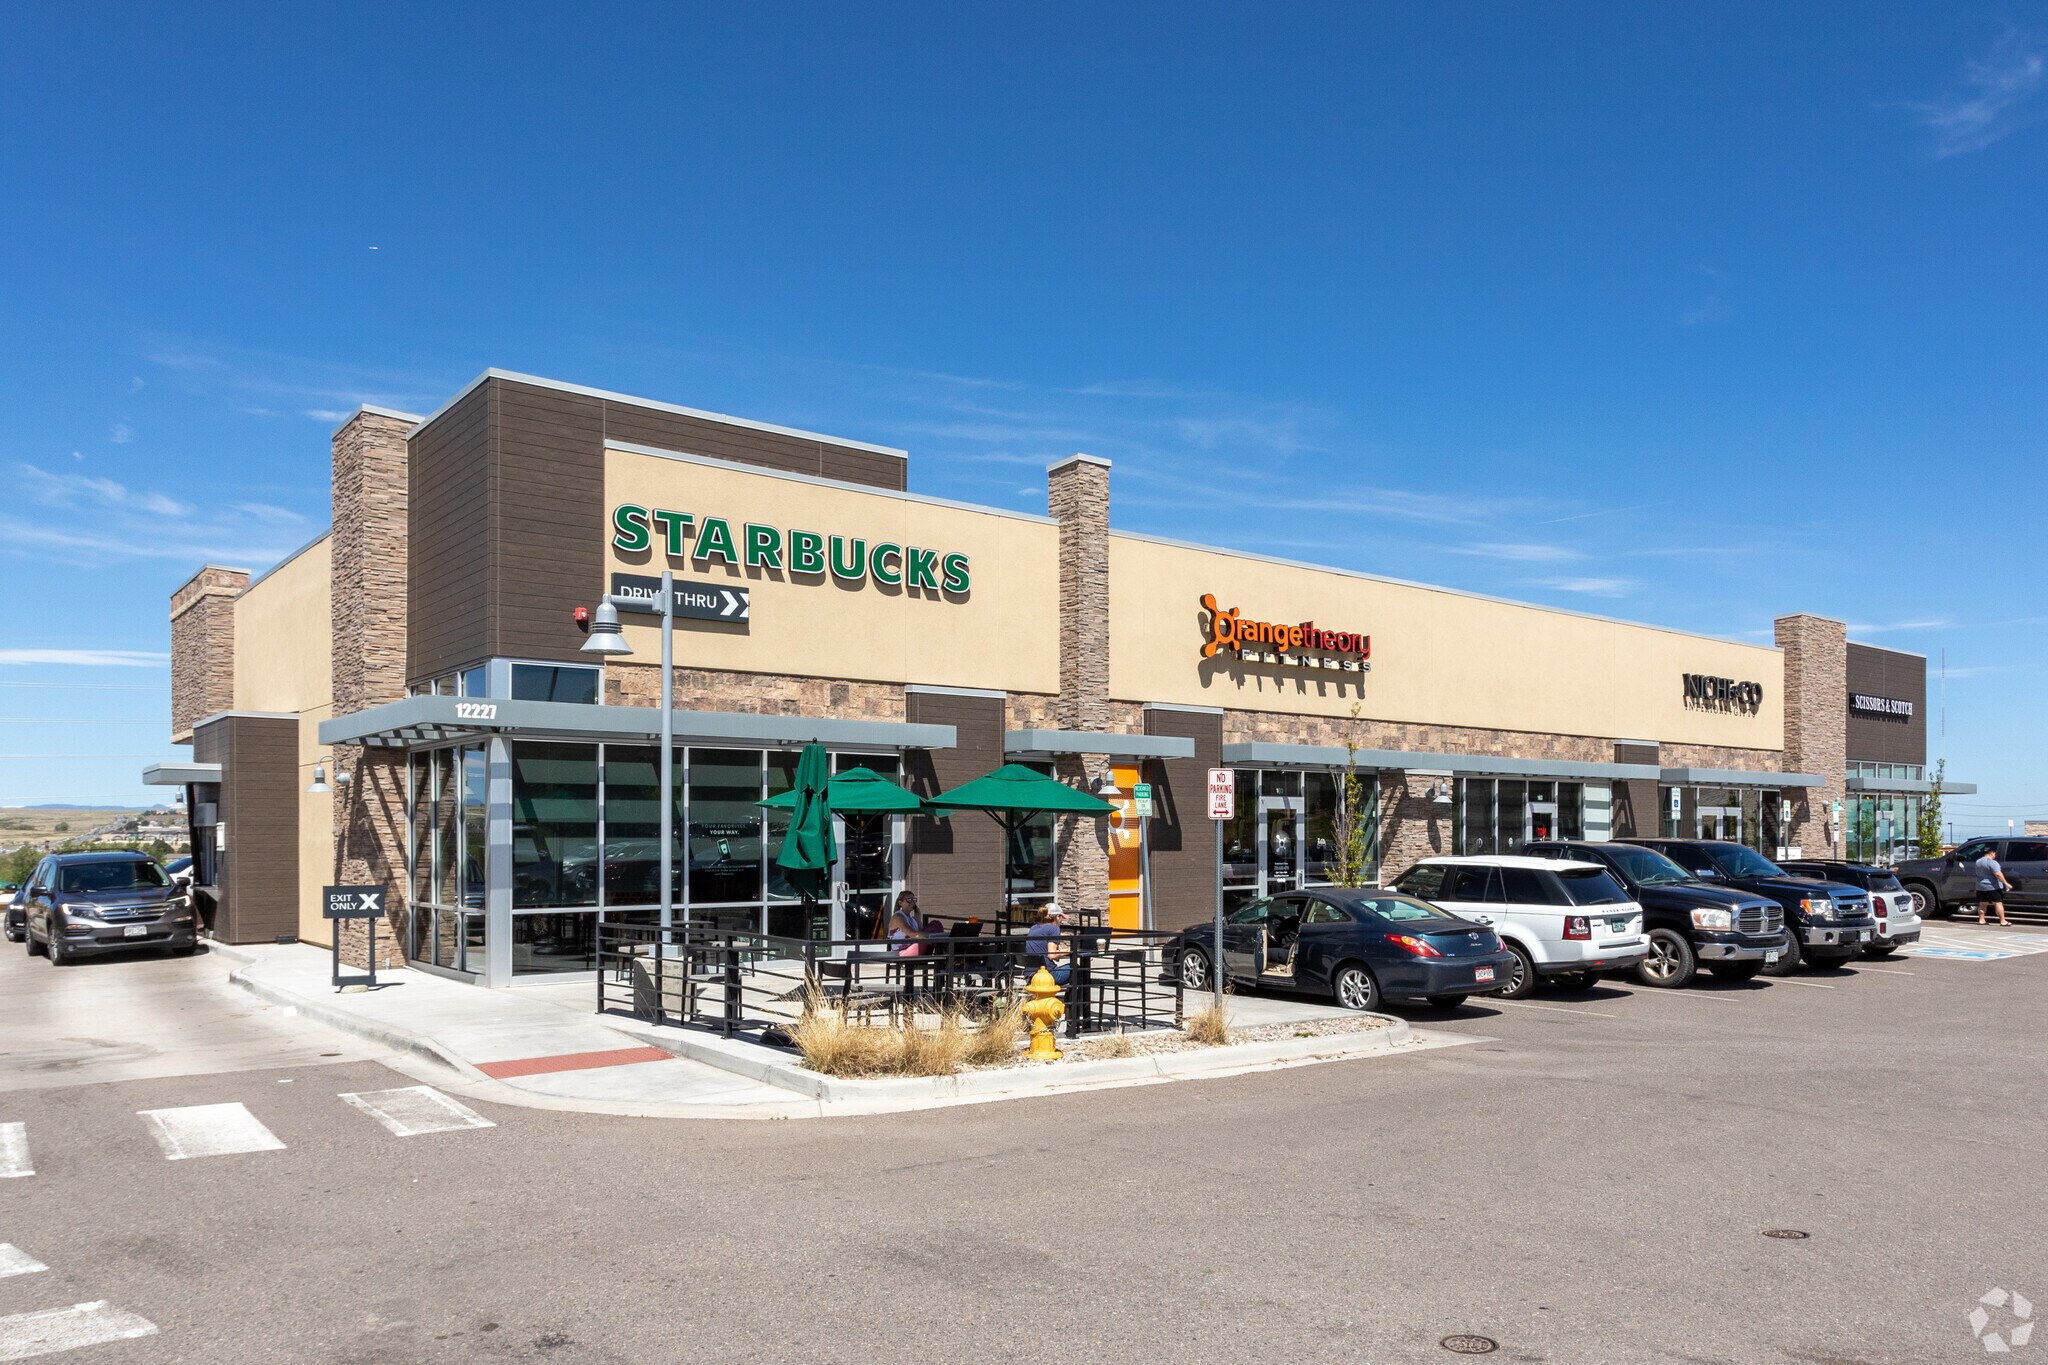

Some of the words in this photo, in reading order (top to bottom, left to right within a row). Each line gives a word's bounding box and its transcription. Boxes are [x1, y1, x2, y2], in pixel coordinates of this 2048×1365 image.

[613, 504, 972, 594] STARBUCKS
[620, 585, 664, 600] DRIV
[674, 591, 717, 609] THRU
[1240, 649, 1371, 673] FITNESS
[1855, 695, 1885, 712] SCISSORS
[1885, 698, 1890, 713] &
[1891, 700, 1913, 716] SCOTCH
[455, 702, 497, 720] 12227
[1216, 773, 1226, 783] NO
[1210, 784, 1232, 794] PARKING
[1215, 794, 1226, 802] FIRE
[1214, 801, 1227, 809] LANE
[330, 894, 353, 902] EXIT
[330, 902, 358, 911] ONLY
